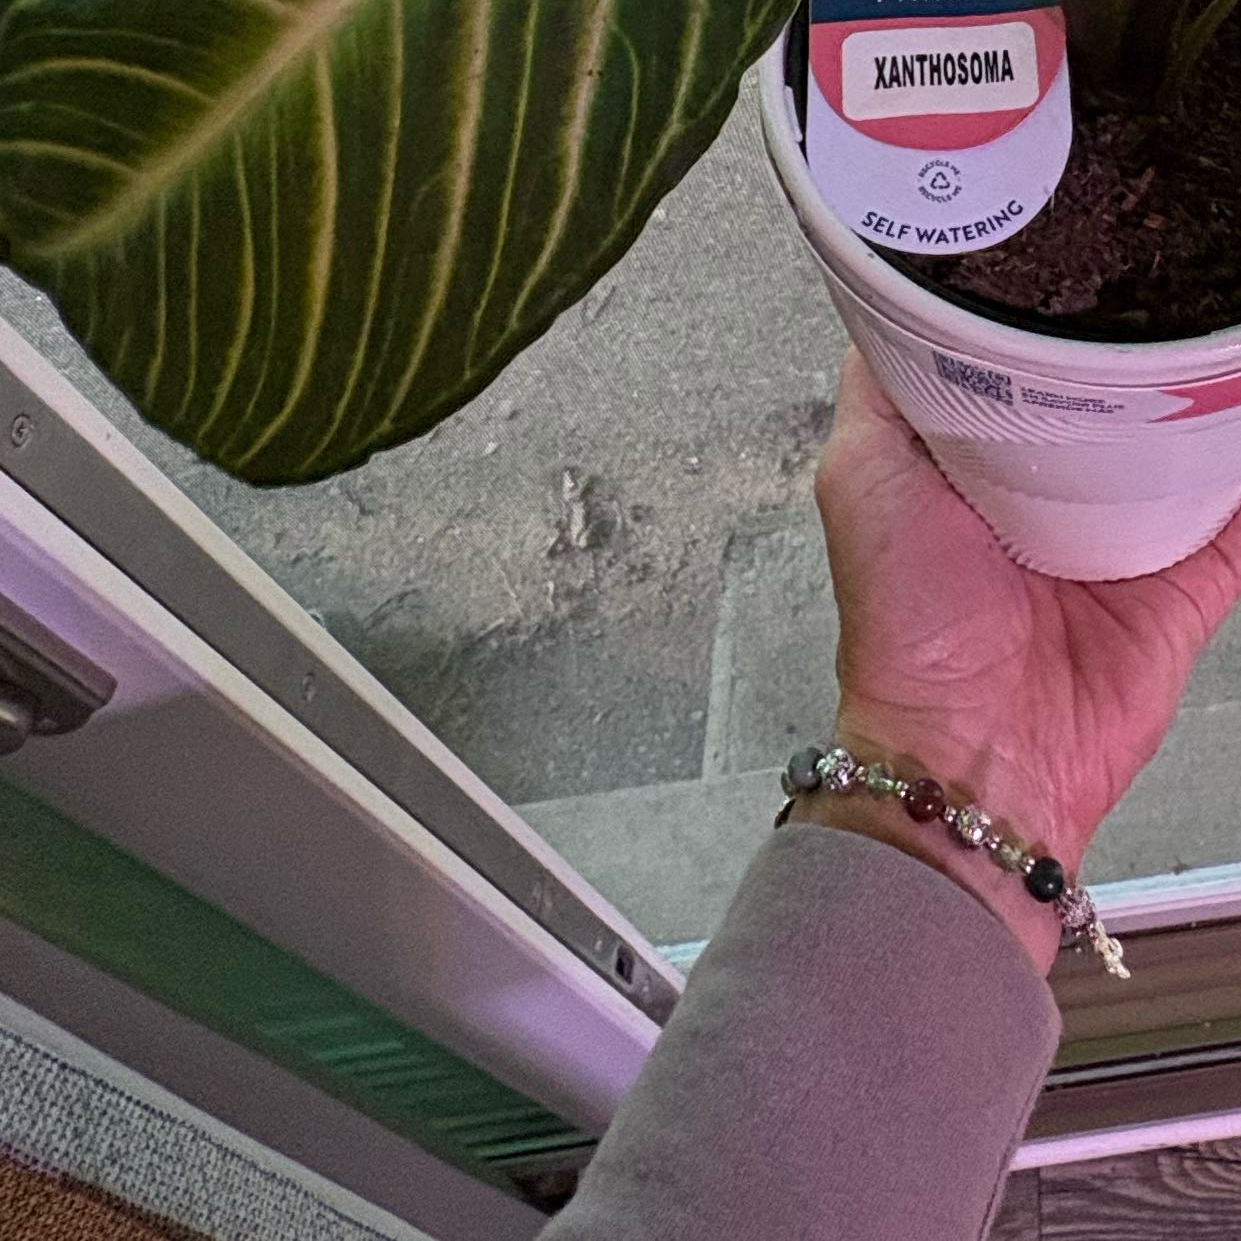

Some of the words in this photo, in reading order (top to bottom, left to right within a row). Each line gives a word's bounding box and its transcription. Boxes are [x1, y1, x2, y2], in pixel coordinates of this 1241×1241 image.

[874, 49, 1014, 90] XANTHOSOMA
[861, 211, 911, 240] SELF
[915, 199, 1024, 245] WATERING
